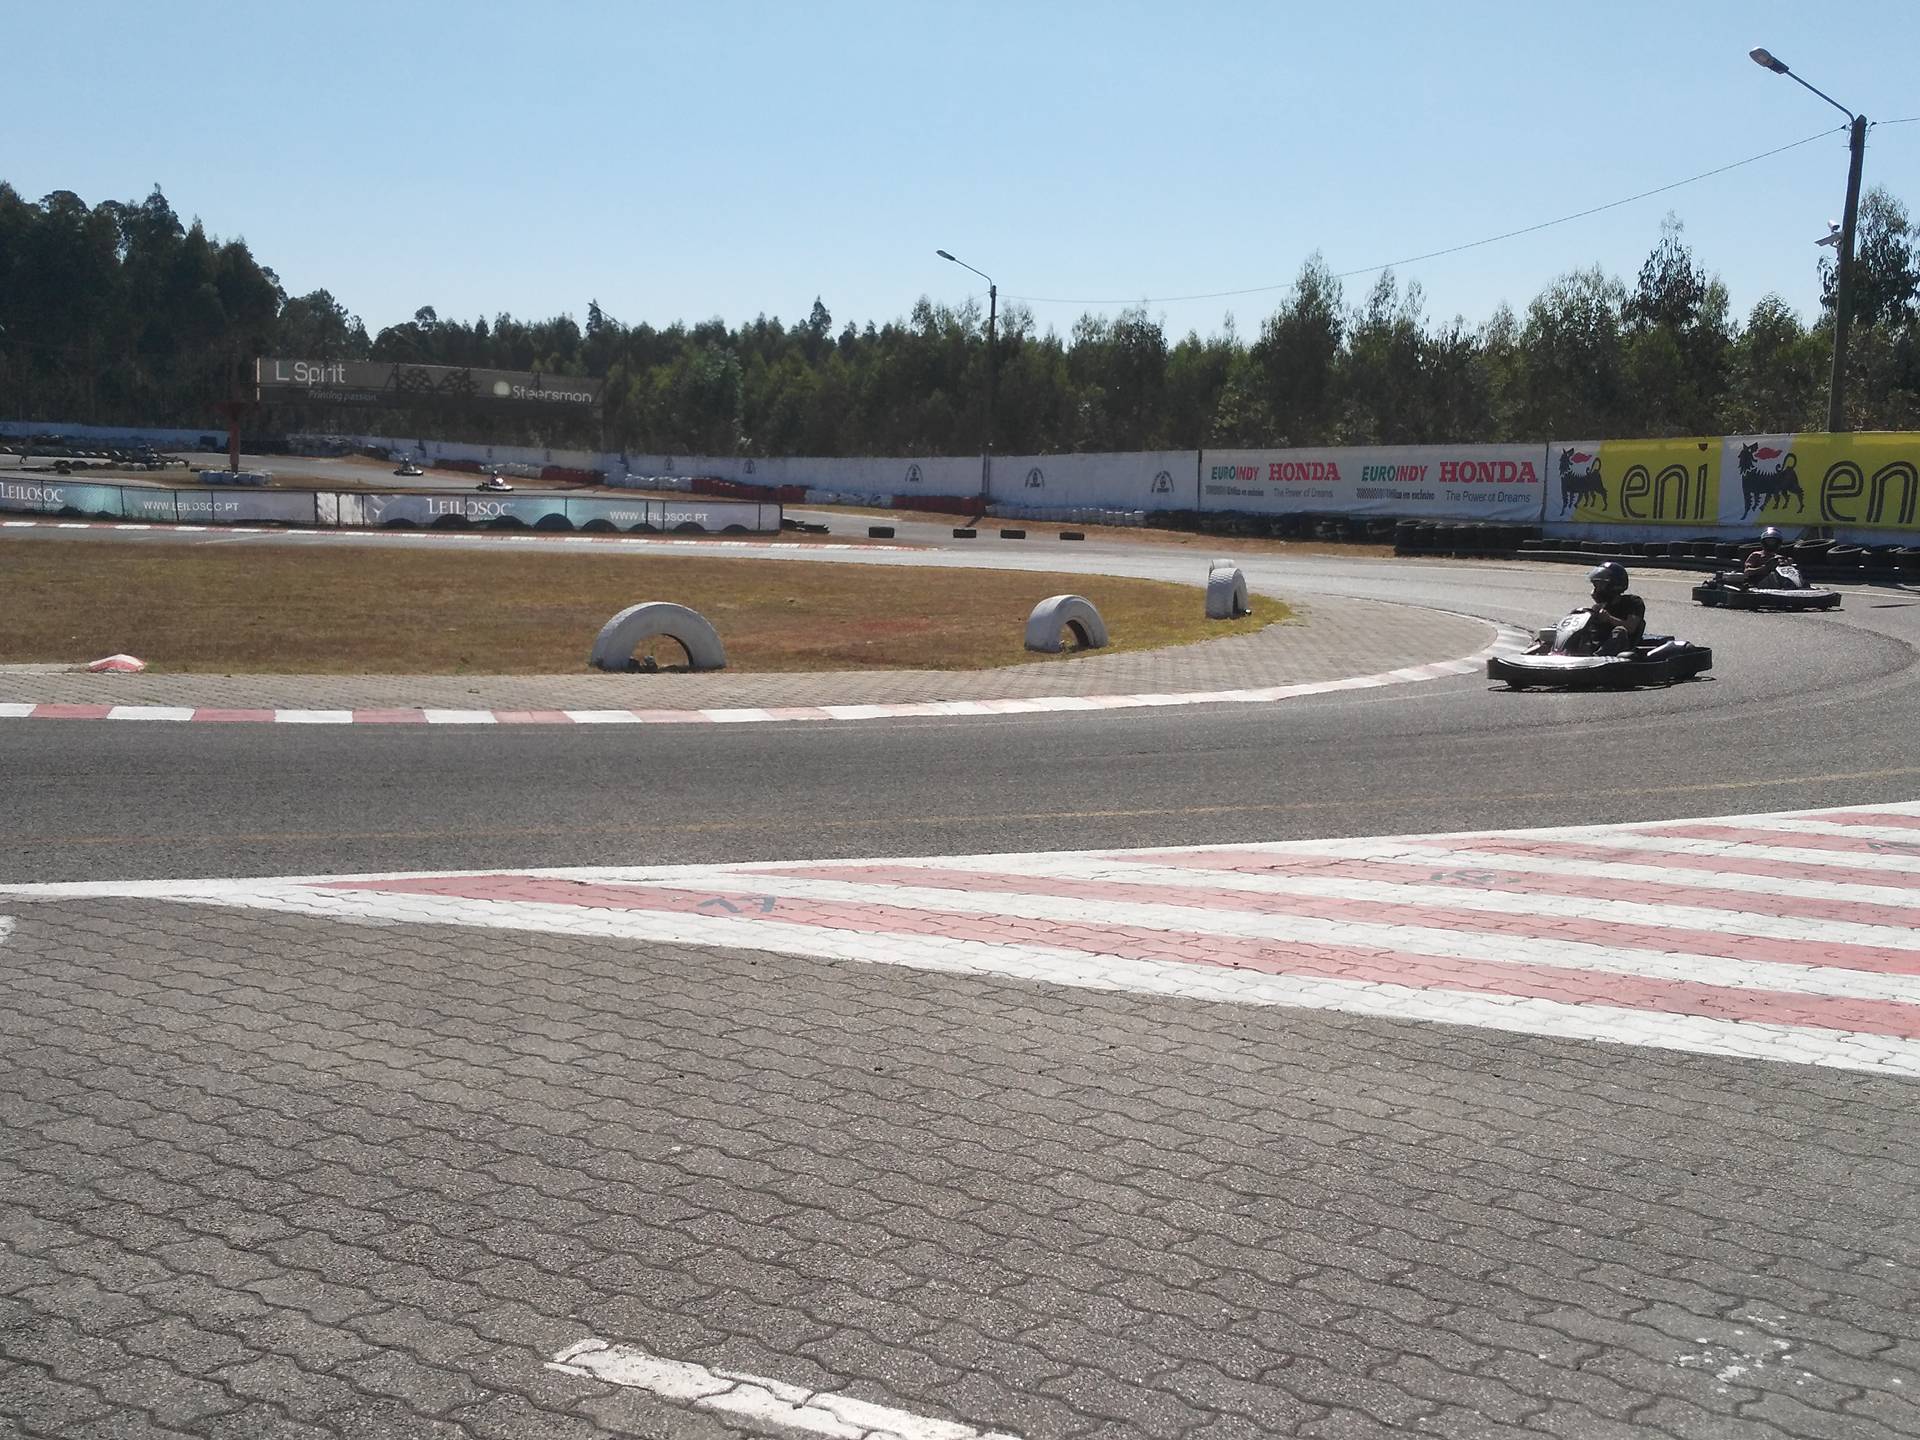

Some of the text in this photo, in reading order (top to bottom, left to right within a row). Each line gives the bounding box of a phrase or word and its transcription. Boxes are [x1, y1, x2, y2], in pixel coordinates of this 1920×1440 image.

[275, 360, 347, 386] L Spirit
[1211, 466, 1260, 481] EUROINDY
[1268, 462, 1341, 481] HONDA
[1361, 465, 1428, 482] EUROINDY
[1439, 461, 1539, 484] HONDA
[1620, 443, 1709, 520] eni
[0, 481, 64, 502] LEILOSOC
[1446, 490, 1461, 502] The
[1462, 490, 1487, 502] Power
[1497, 491, 1531, 503] Dreams
[425, 497, 512, 516] LEILOSOC
